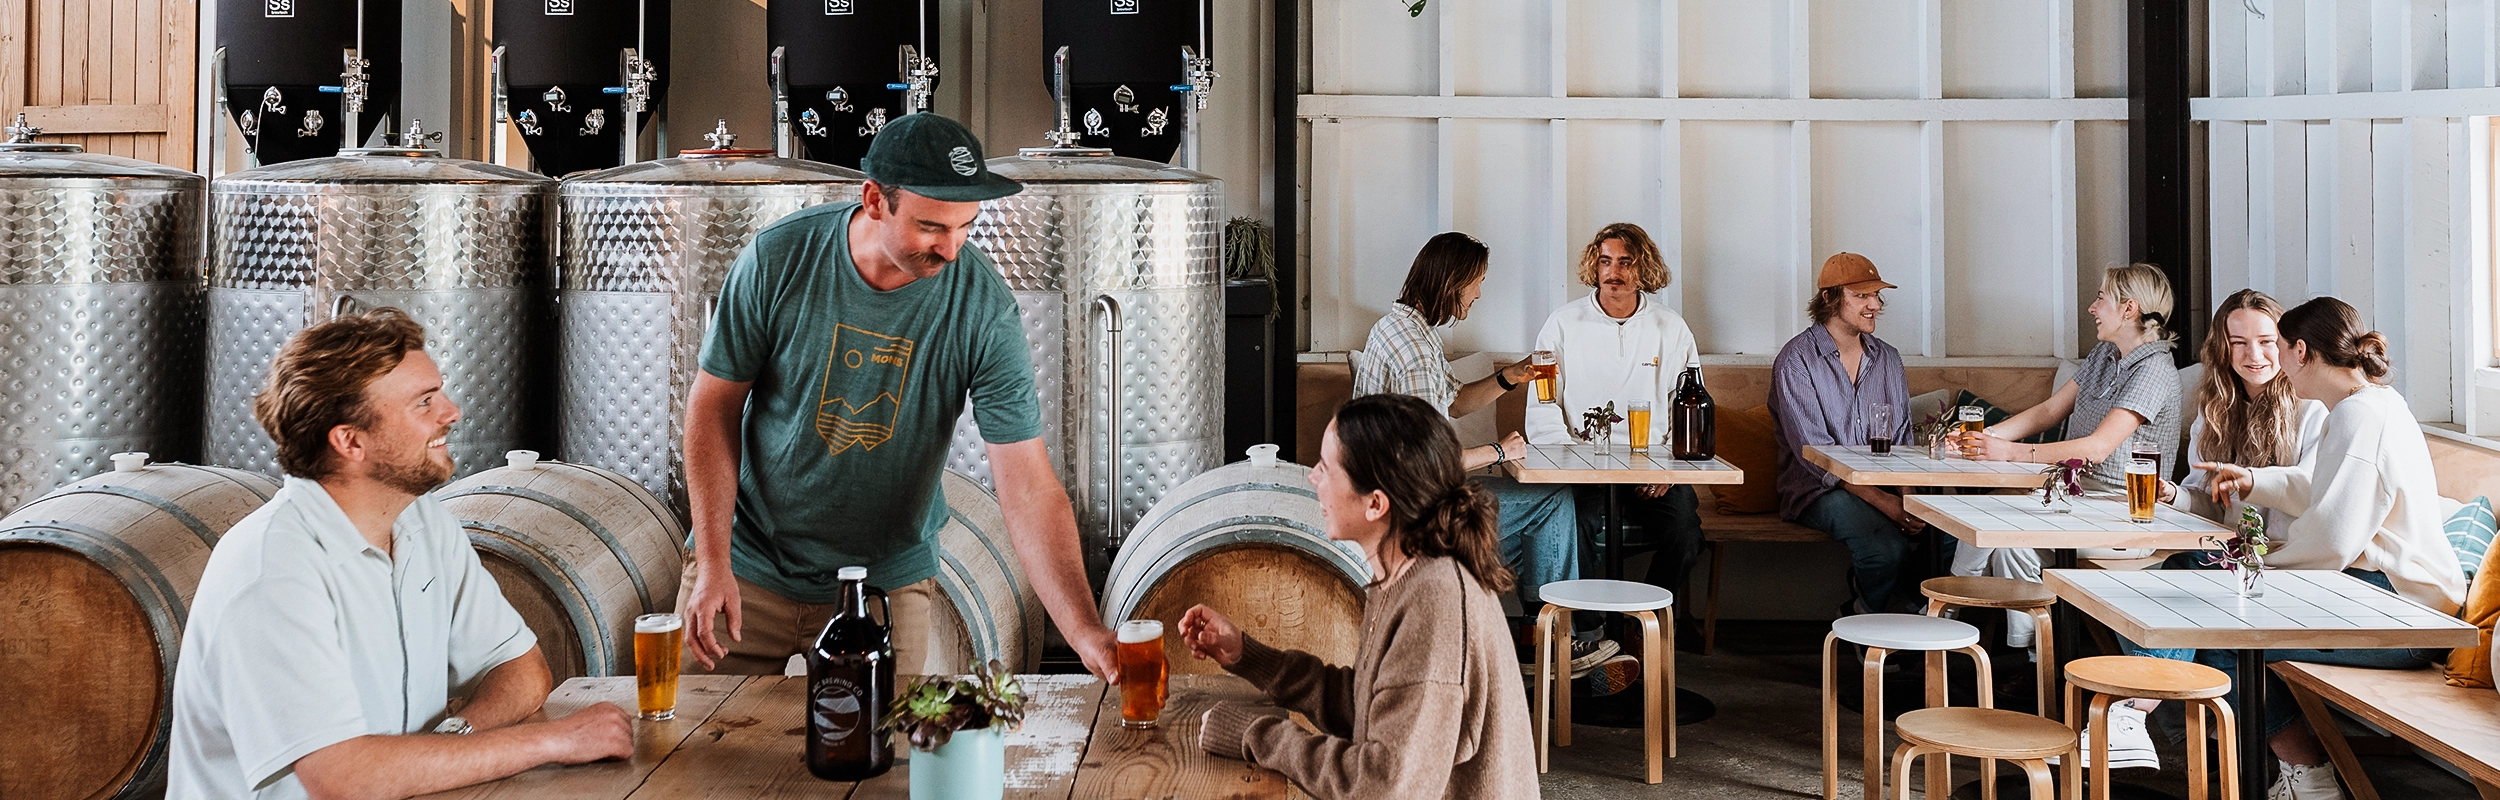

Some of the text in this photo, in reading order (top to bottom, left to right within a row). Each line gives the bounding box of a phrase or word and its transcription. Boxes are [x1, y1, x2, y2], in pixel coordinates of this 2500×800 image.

[269, 0, 290, 10] Ss
[821, 677, 853, 689] BREWING
[852, 685, 864, 697] CO
